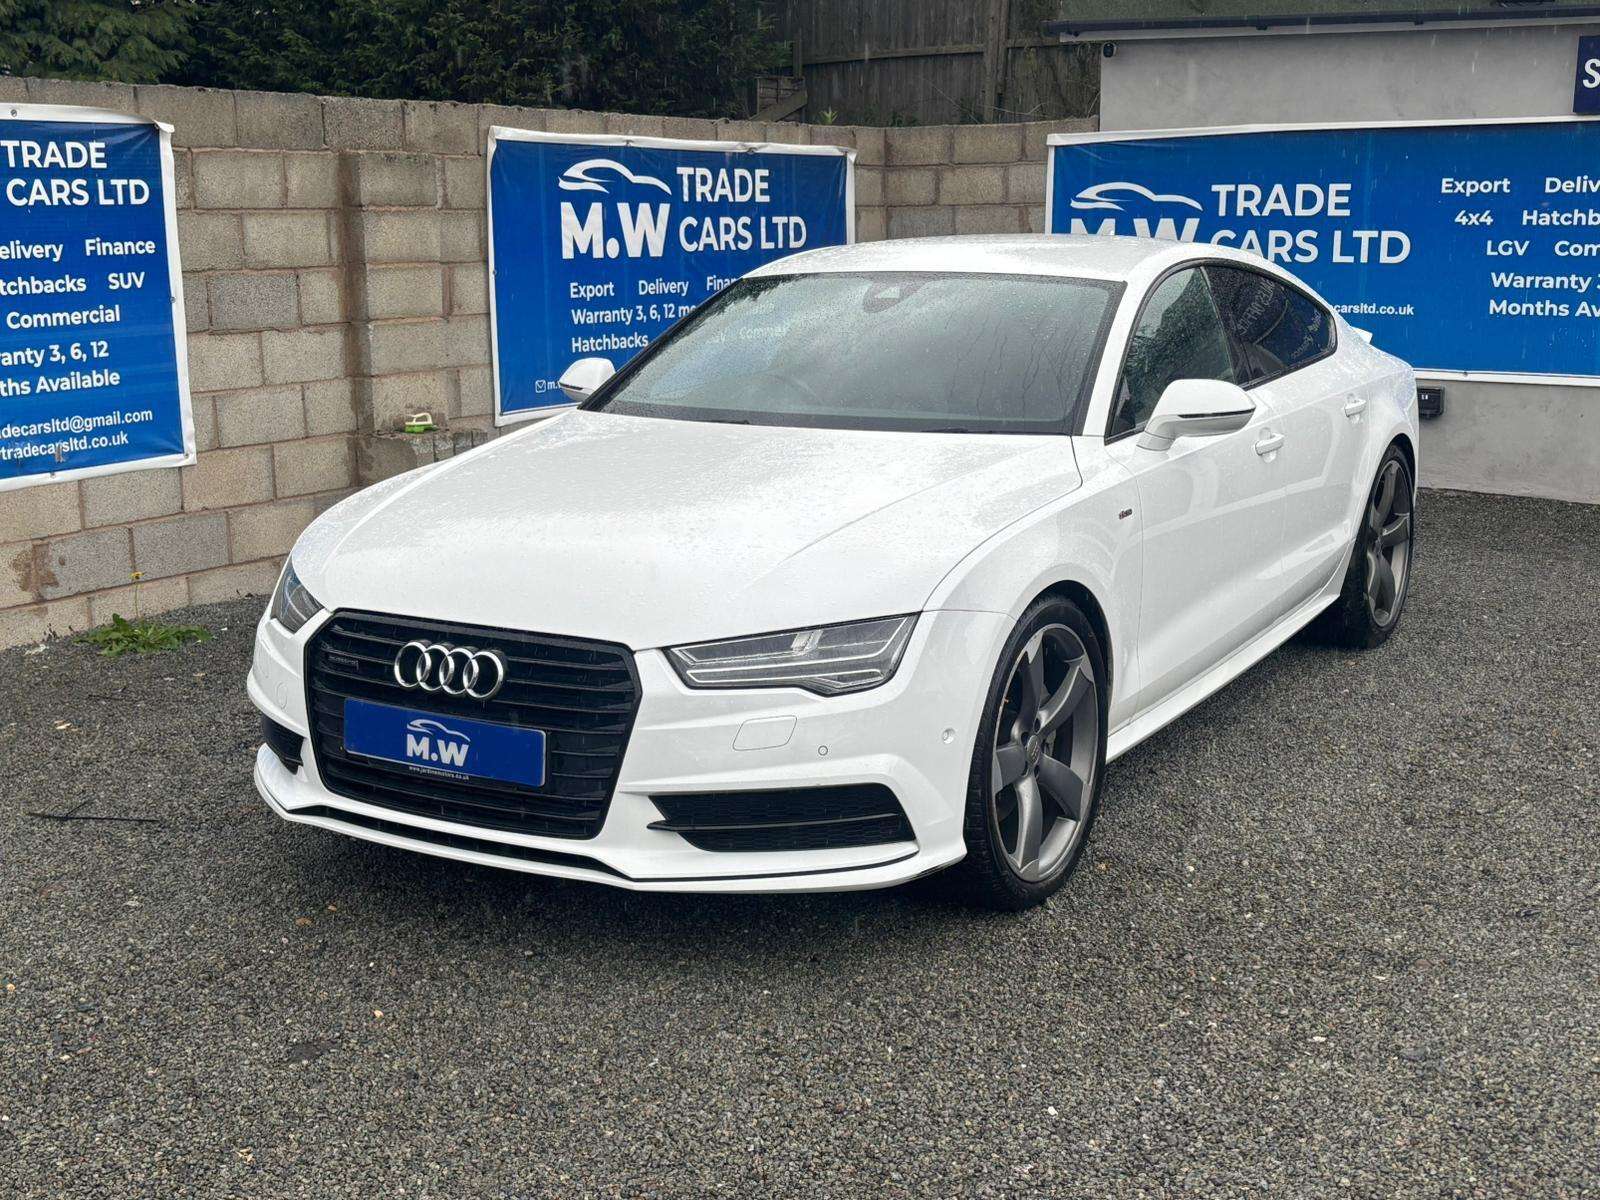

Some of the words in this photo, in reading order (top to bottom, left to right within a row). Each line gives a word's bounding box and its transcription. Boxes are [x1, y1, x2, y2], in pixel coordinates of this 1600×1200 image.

[0, 140, 107, 168] TRADE
[7, 179, 89, 206] CARS
[98, 180, 149, 204] LTD
[677, 167, 769, 202] TRADE
[1442, 178, 1510, 196] Export
[1545, 176, 1600, 192] Deliv
[1212, 184, 1351, 216] TRADE
[1455, 211, 1493, 225] 4x4
[1523, 209, 1600, 225] Hatchb
[561, 202, 670, 259] M.W
[680, 217, 752, 251] CARS
[761, 217, 806, 249] LTD
[86, 238, 155, 255] Finance
[1333, 231, 1410, 263] LTD
[1487, 241, 1529, 255] LGV
[109, 272, 144, 289] SUV
[571, 282, 614, 300] Export
[639, 279, 688, 296] Delivery
[1492, 273, 1591, 292] Warranty
[7, 305, 120, 329] Commercial
[572, 308, 632, 324] Warranty
[637, 306, 646, 322] 3,
[650, 305, 660, 321] 6,
[664, 304, 675, 318] 12
[1331, 301, 1414, 316] carsltd.co.uk
[1490, 300, 1569, 316] Months
[0, 348, 44, 367] anty
[49, 345, 65, 363] 3,
[71, 343, 86, 361] 6,
[91, 341, 108, 357] 12
[573, 333, 648, 352] Hatchbacks
[36, 370, 120, 393] Available
[0, 410, 152, 439] decarsltd@gmail.com
[0, 431, 128, 461] tradecarsltd.co.uk
[406, 734, 469, 766] M.W
